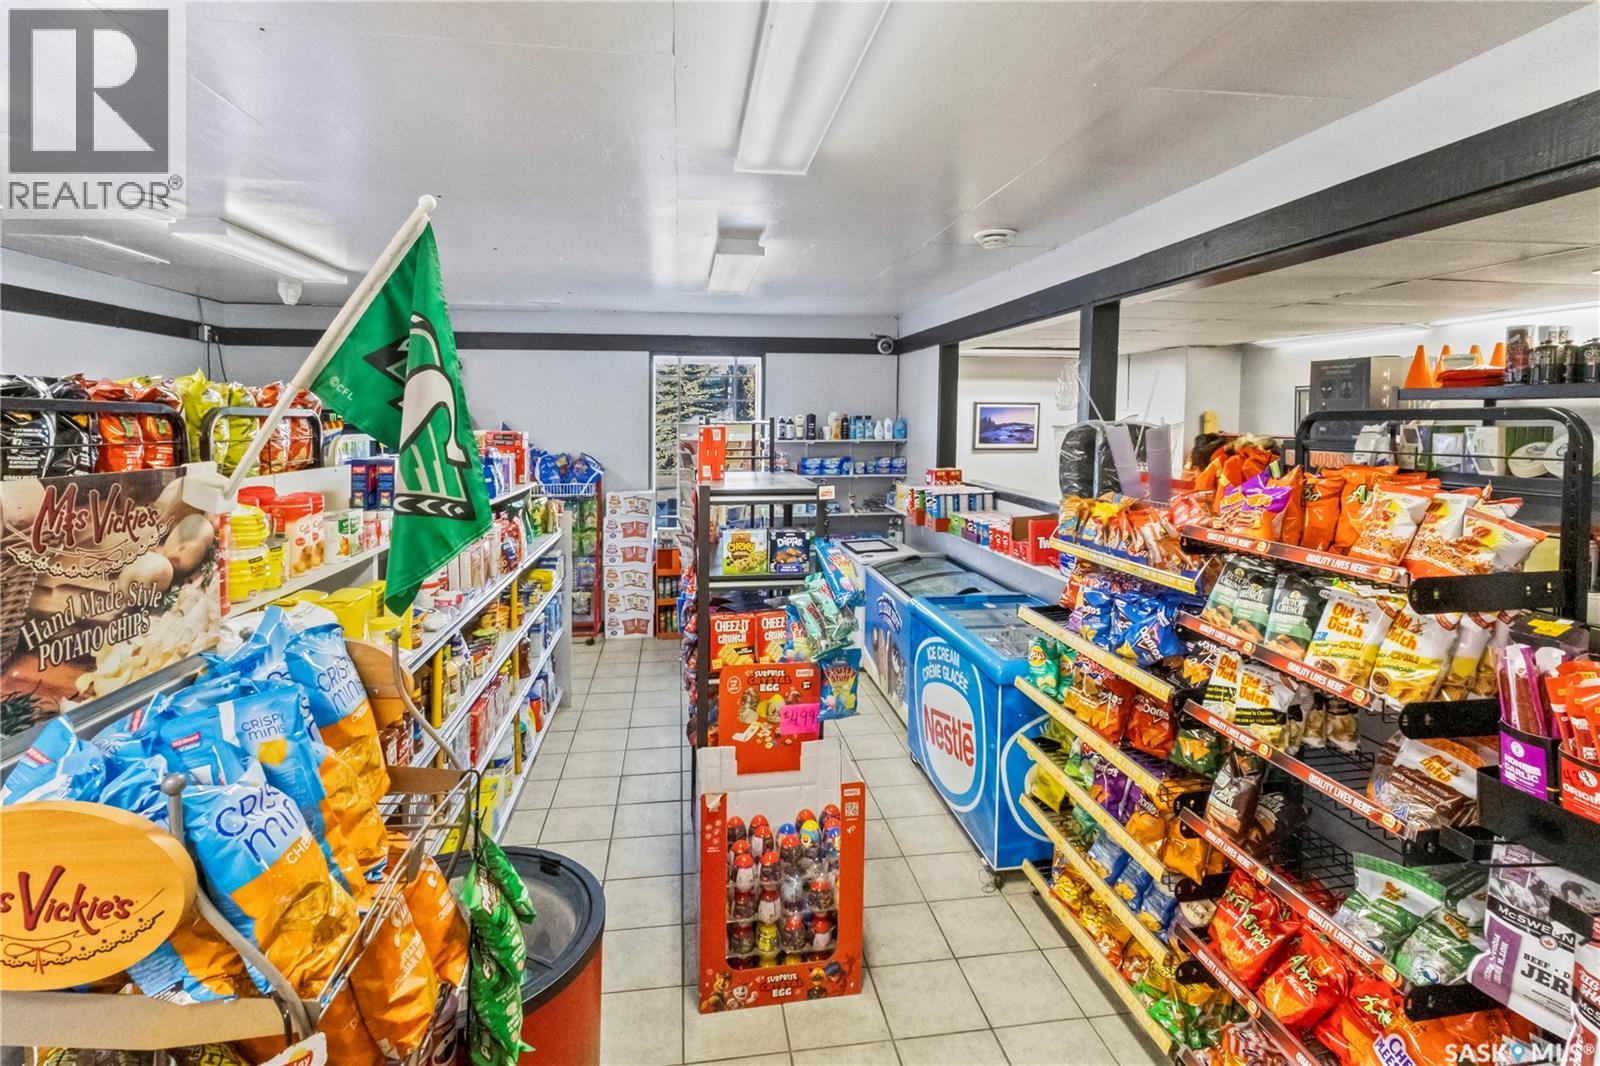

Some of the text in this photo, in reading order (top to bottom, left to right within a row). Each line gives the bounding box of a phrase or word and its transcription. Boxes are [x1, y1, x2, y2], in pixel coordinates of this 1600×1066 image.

[89, 483, 159, 544] Vickie's
[1306, 553, 1370, 574] QUALITY LIVES HERE
[20, 581, 163, 651] Hand Made Style
[1276, 603, 1306, 616] CRUNCH
[1332, 602, 1356, 619] Old
[761, 617, 786, 629] CHEEZ
[1327, 616, 1364, 639] Dutch
[38, 608, 152, 672] POTATO CHIPS
[717, 633, 748, 645] CRUNCH
[764, 630, 786, 641] CRUNC
[926, 646, 961, 668] ICE CREAM
[1220, 654, 1238, 670] Old
[754, 669, 785, 678] SURPRISE
[922, 665, 969, 696] CRÈME GLACÉE
[1215, 666, 1238, 684] Dut
[1286, 661, 1346, 693] QUALITY LIVES HERE
[759, 683, 780, 693] EGG
[923, 704, 975, 767] Nestlé
[1504, 762, 1540, 784] GARLIC
[1307, 773, 1373, 816] QUALITY LIVES HERE
[1223, 844, 1239, 860] LIVES
[1236, 853, 1254, 869] HERE
[18, 865, 135, 936] Vickie's
[1306, 909, 1375, 964] QUALITY LIVES HERE
[1523, 953, 1551, 969] BEEF
[766, 972, 798, 984] SURPRISE
[1214, 968, 1230, 986] LIVES
[1227, 980, 1245, 998] HERE
[1520, 963, 1572, 999] JER
[771, 987, 793, 998] EGG
